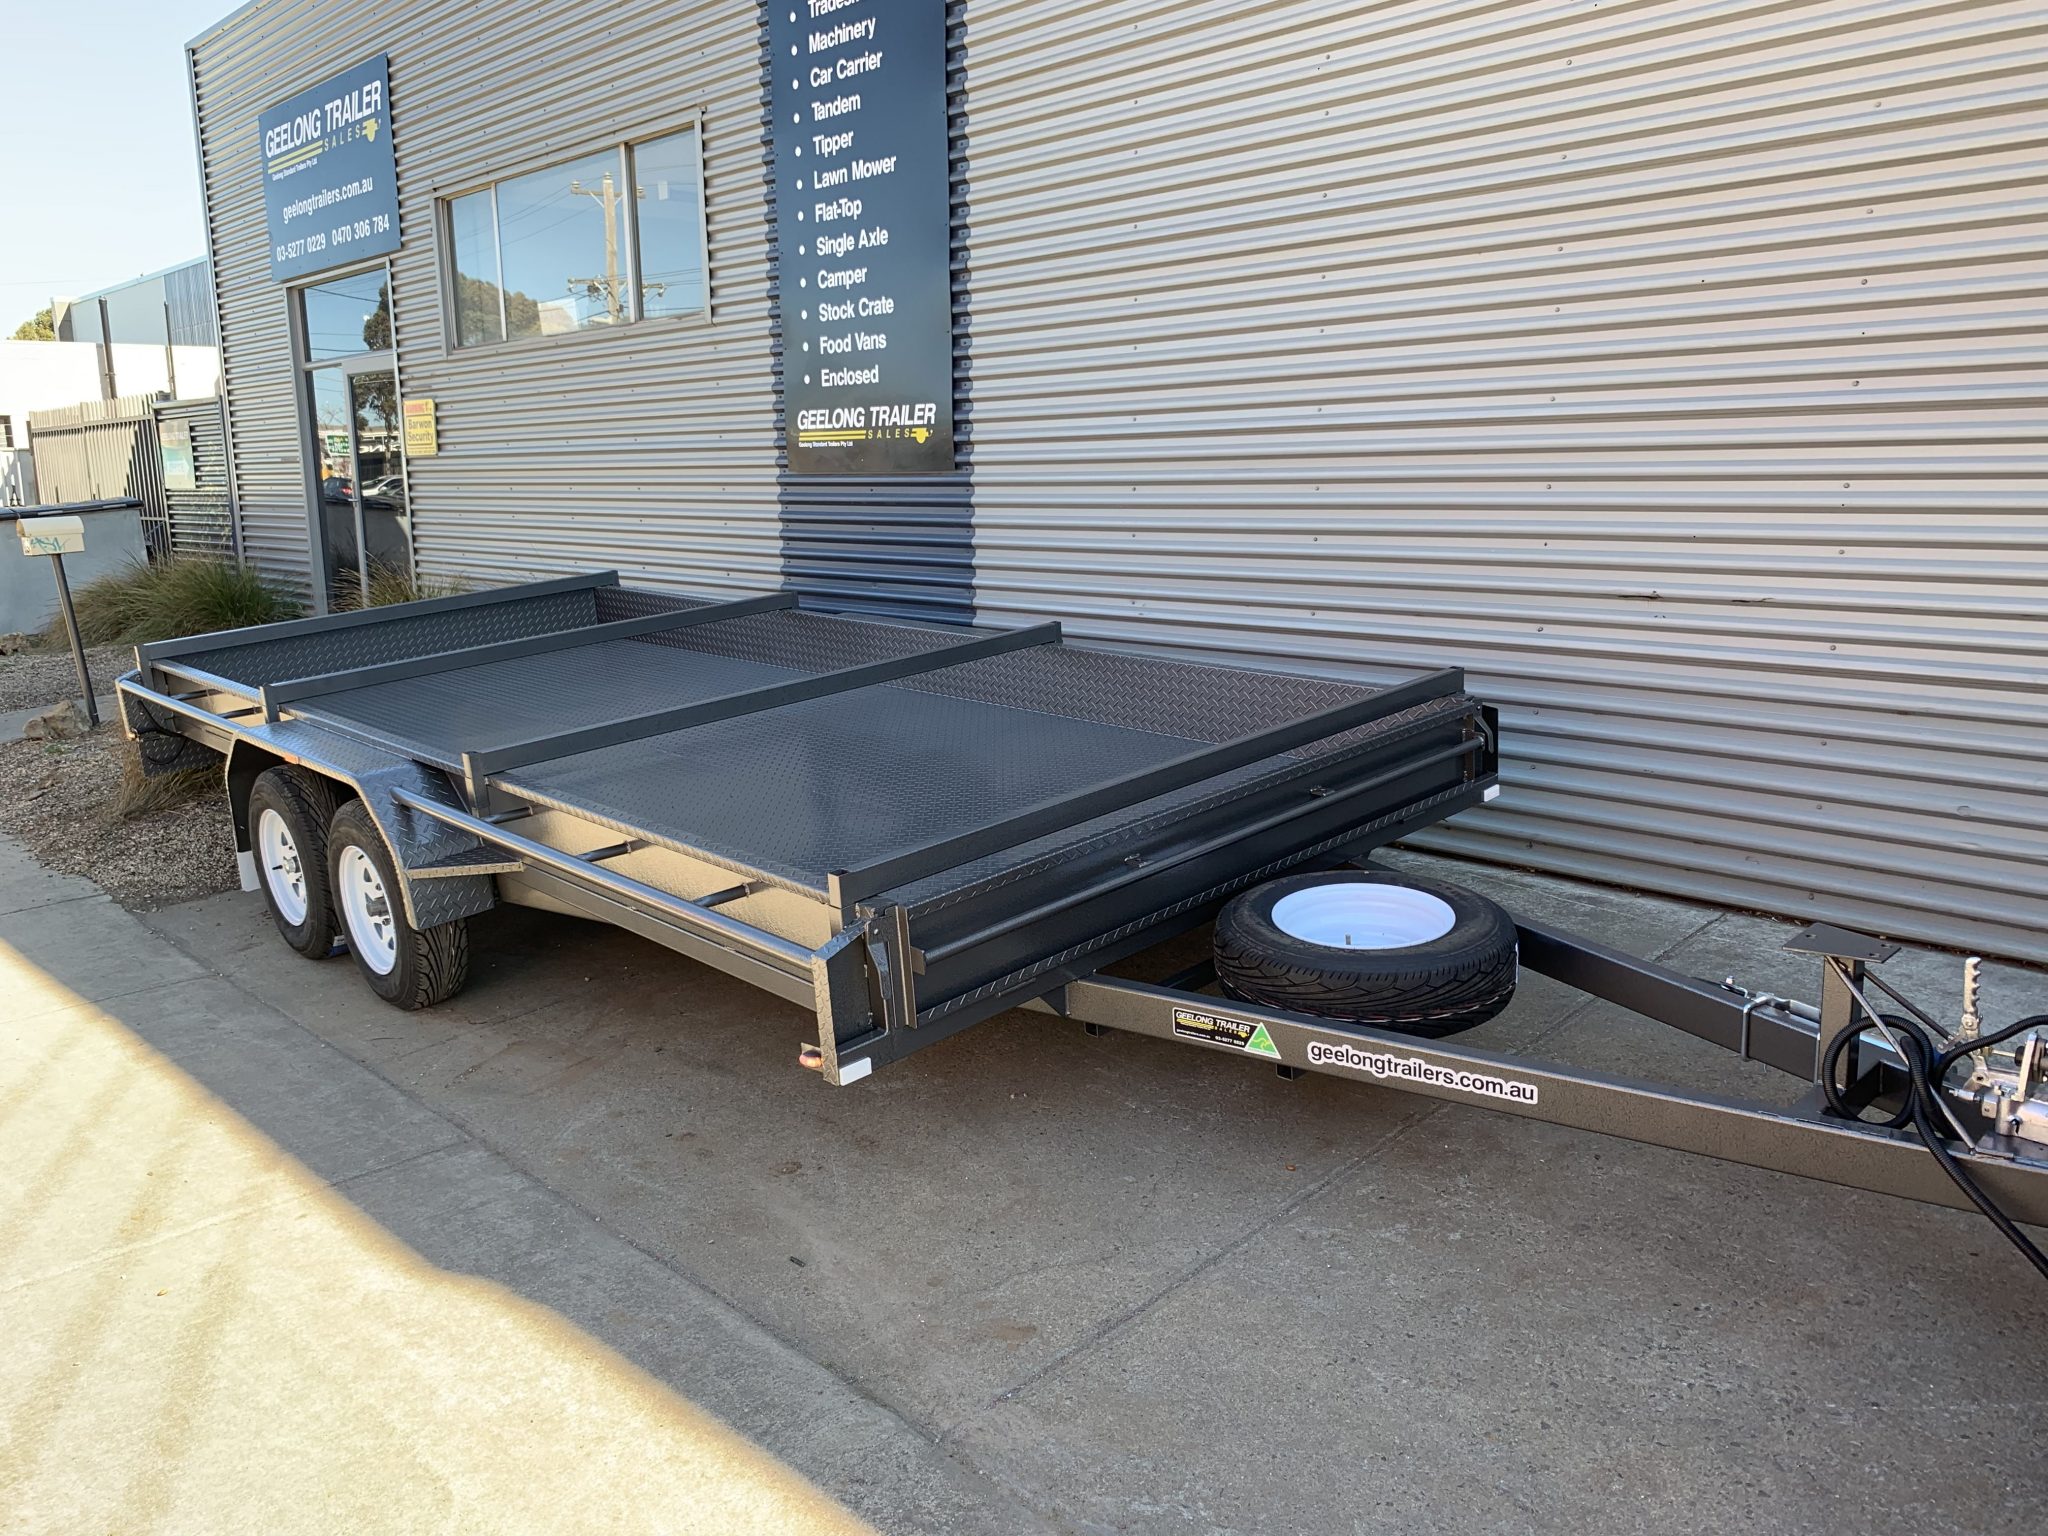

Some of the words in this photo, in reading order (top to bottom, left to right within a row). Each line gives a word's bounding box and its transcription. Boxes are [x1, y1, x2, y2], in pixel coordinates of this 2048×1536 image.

[808, 0, 860, 18] Trades
[808, 17, 876, 54] Machinery
[810, 67, 833, 88] Car
[836, 51, 883, 80] Carrier
[265, 108, 321, 158] GEELONG
[324, 79, 382, 133] TRAILER
[811, 93, 861, 121] Tandem
[324, 123, 361, 152] SALES
[812, 130, 854, 158] Tipper
[814, 167, 848, 190] Lawn
[851, 155, 897, 181] Mower
[282, 176, 374, 225] geelongtrailers.com.au
[815, 198, 863, 223] Flat-Top
[276, 238, 305, 262] 03-5277
[307, 233, 326, 254] 0229
[331, 225, 352, 247] 0470
[354, 219, 371, 240] 306
[372, 213, 390, 234] 784
[816, 231, 855, 257] Single
[858, 226, 889, 250] Axle
[817, 267, 868, 290] Camper
[818, 299, 856, 322] Stock
[858, 295, 895, 317] Crate
[820, 333, 852, 355] Food
[855, 332, 887, 350] Vans
[821, 364, 880, 387] Enclosed
[408, 419, 433, 430] Barwon
[797, 406, 865, 430] GEELONG
[869, 402, 937, 427] TRAILER
[408, 431, 434, 443] Security
[867, 427, 910, 440] SALES
[1175, 1011, 1214, 1025] GEELONG
[1215, 1019, 1250, 1033] TRAILER
[1214, 1026, 1237, 1035] SALES
[1310, 1045, 1535, 1101] geelongtrailers.com.au
